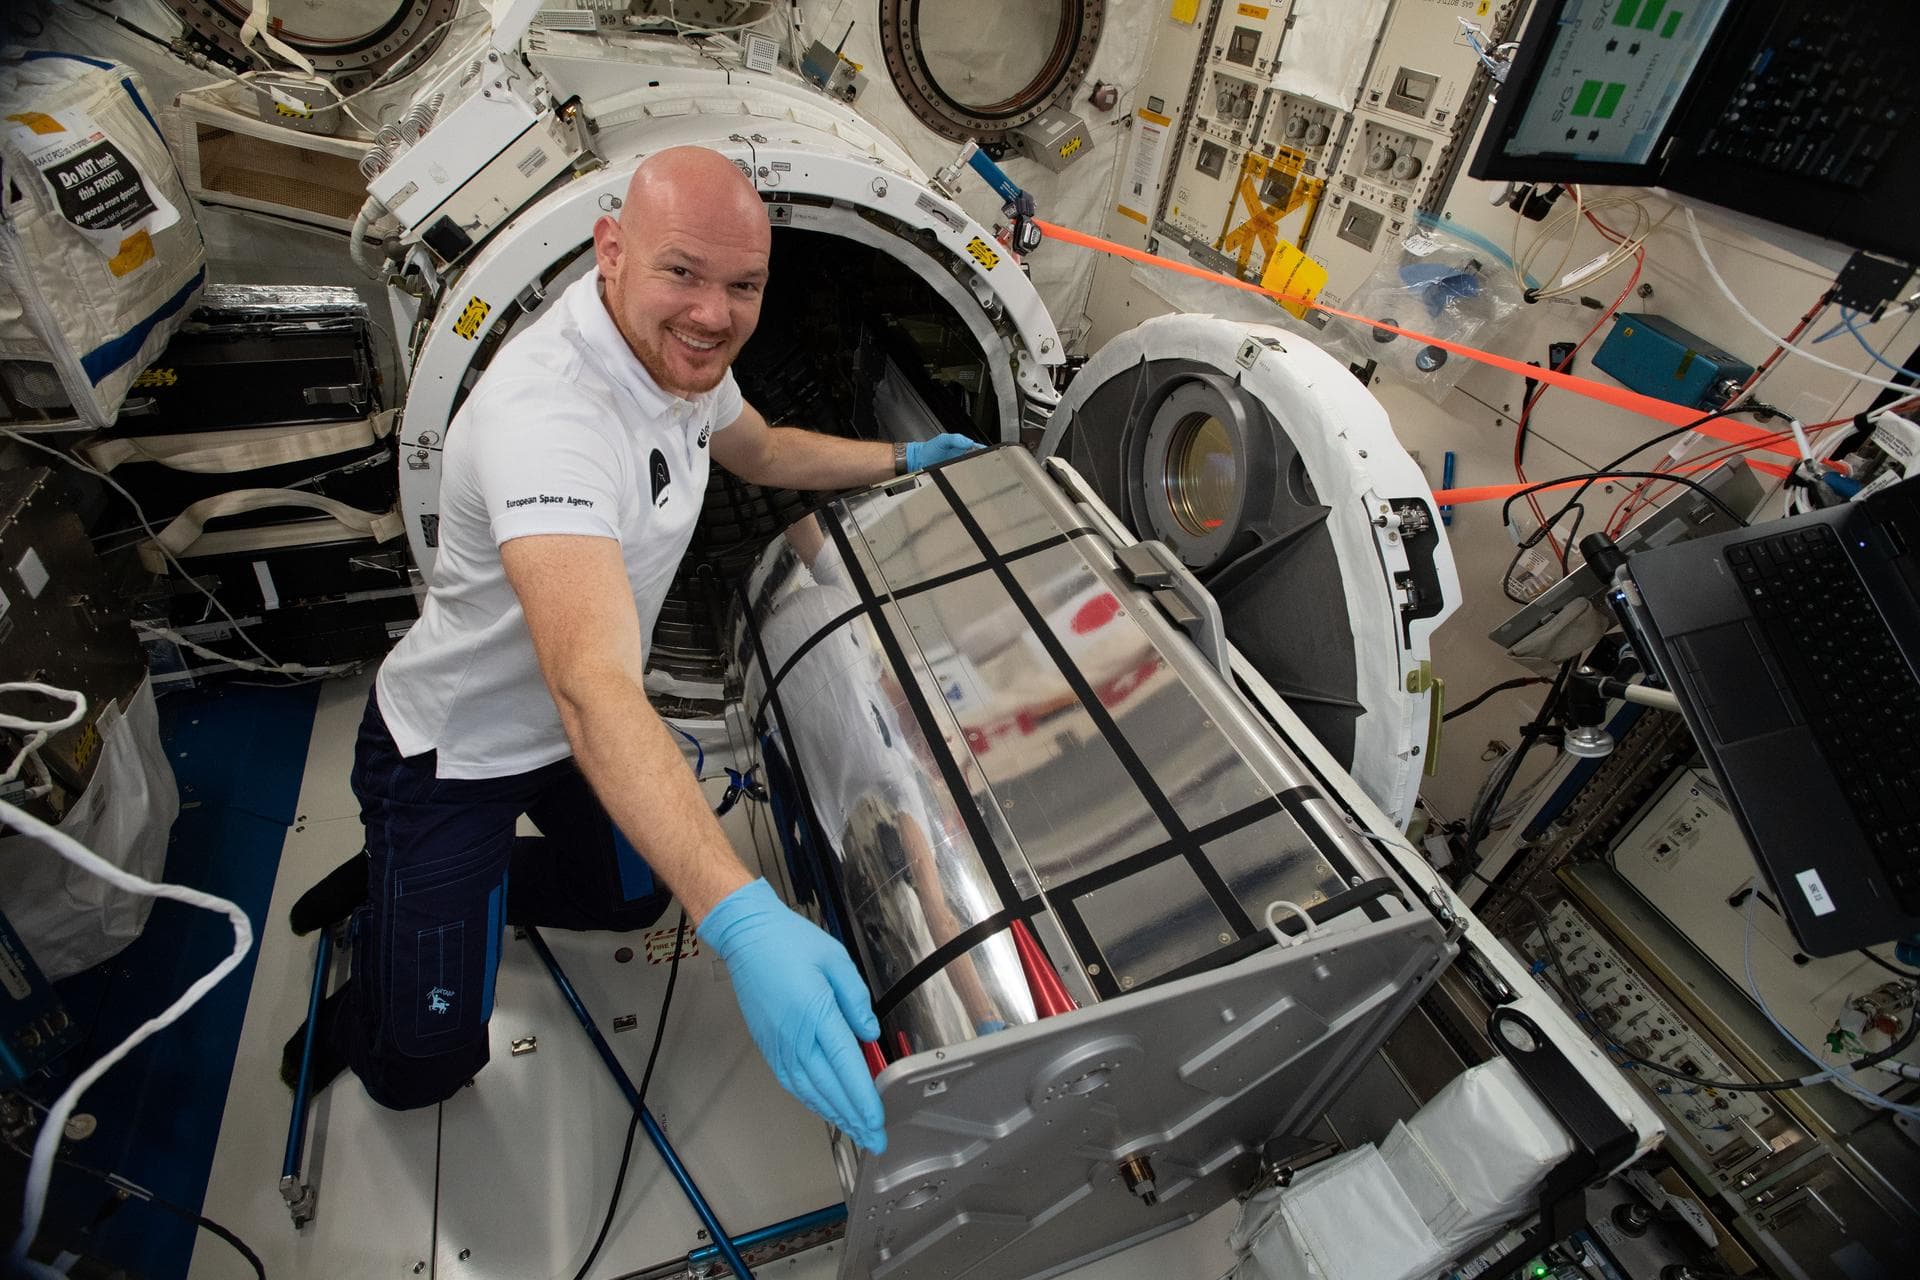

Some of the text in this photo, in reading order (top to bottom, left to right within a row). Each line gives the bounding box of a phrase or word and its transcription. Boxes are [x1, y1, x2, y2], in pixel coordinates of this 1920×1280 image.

[58, 152, 117, 188] Do NOT touch
[79, 185, 96, 201] this
[506, 494, 594, 508] European Space Agency
[653, 942, 670, 952] FIRE
